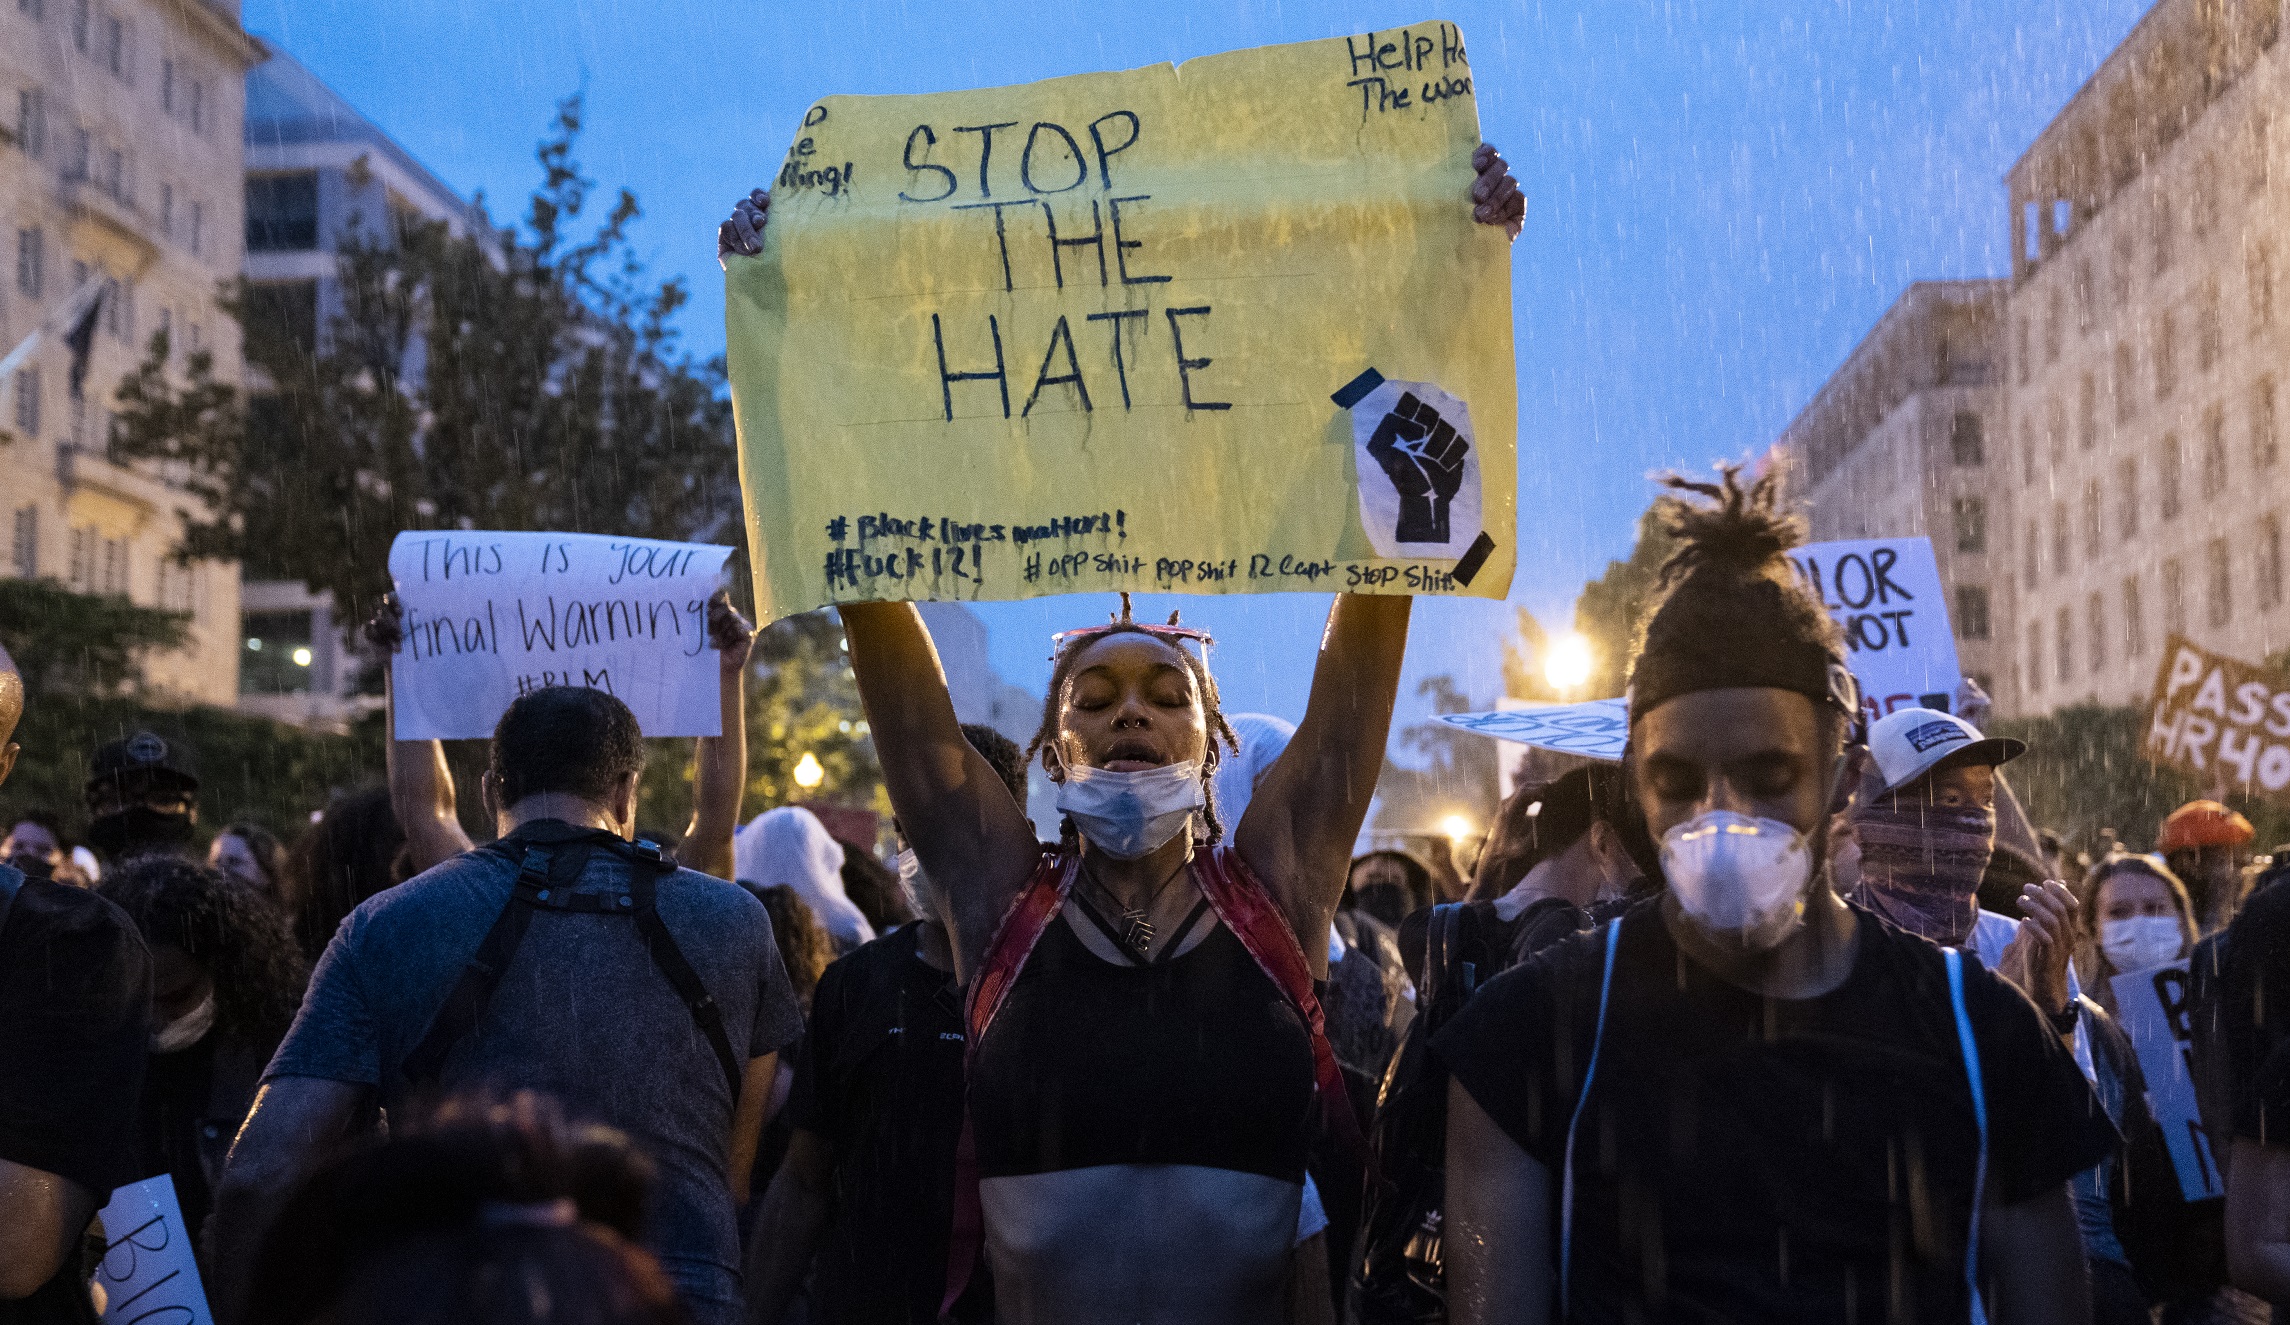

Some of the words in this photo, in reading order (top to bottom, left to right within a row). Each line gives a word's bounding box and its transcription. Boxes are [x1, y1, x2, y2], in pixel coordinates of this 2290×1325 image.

[1346, 77, 1412, 112] The
[1421, 76, 1472, 103] wor
[780, 161, 853, 196] lling!
[898, 110, 1140, 202] STOP
[950, 195, 1173, 293] THE
[932, 306, 1232, 422] HATE
[405, 538, 502, 582] This
[610, 542, 702, 585] your
[1790, 549, 1914, 609] LOR
[2167, 649, 2290, 738] PASS
